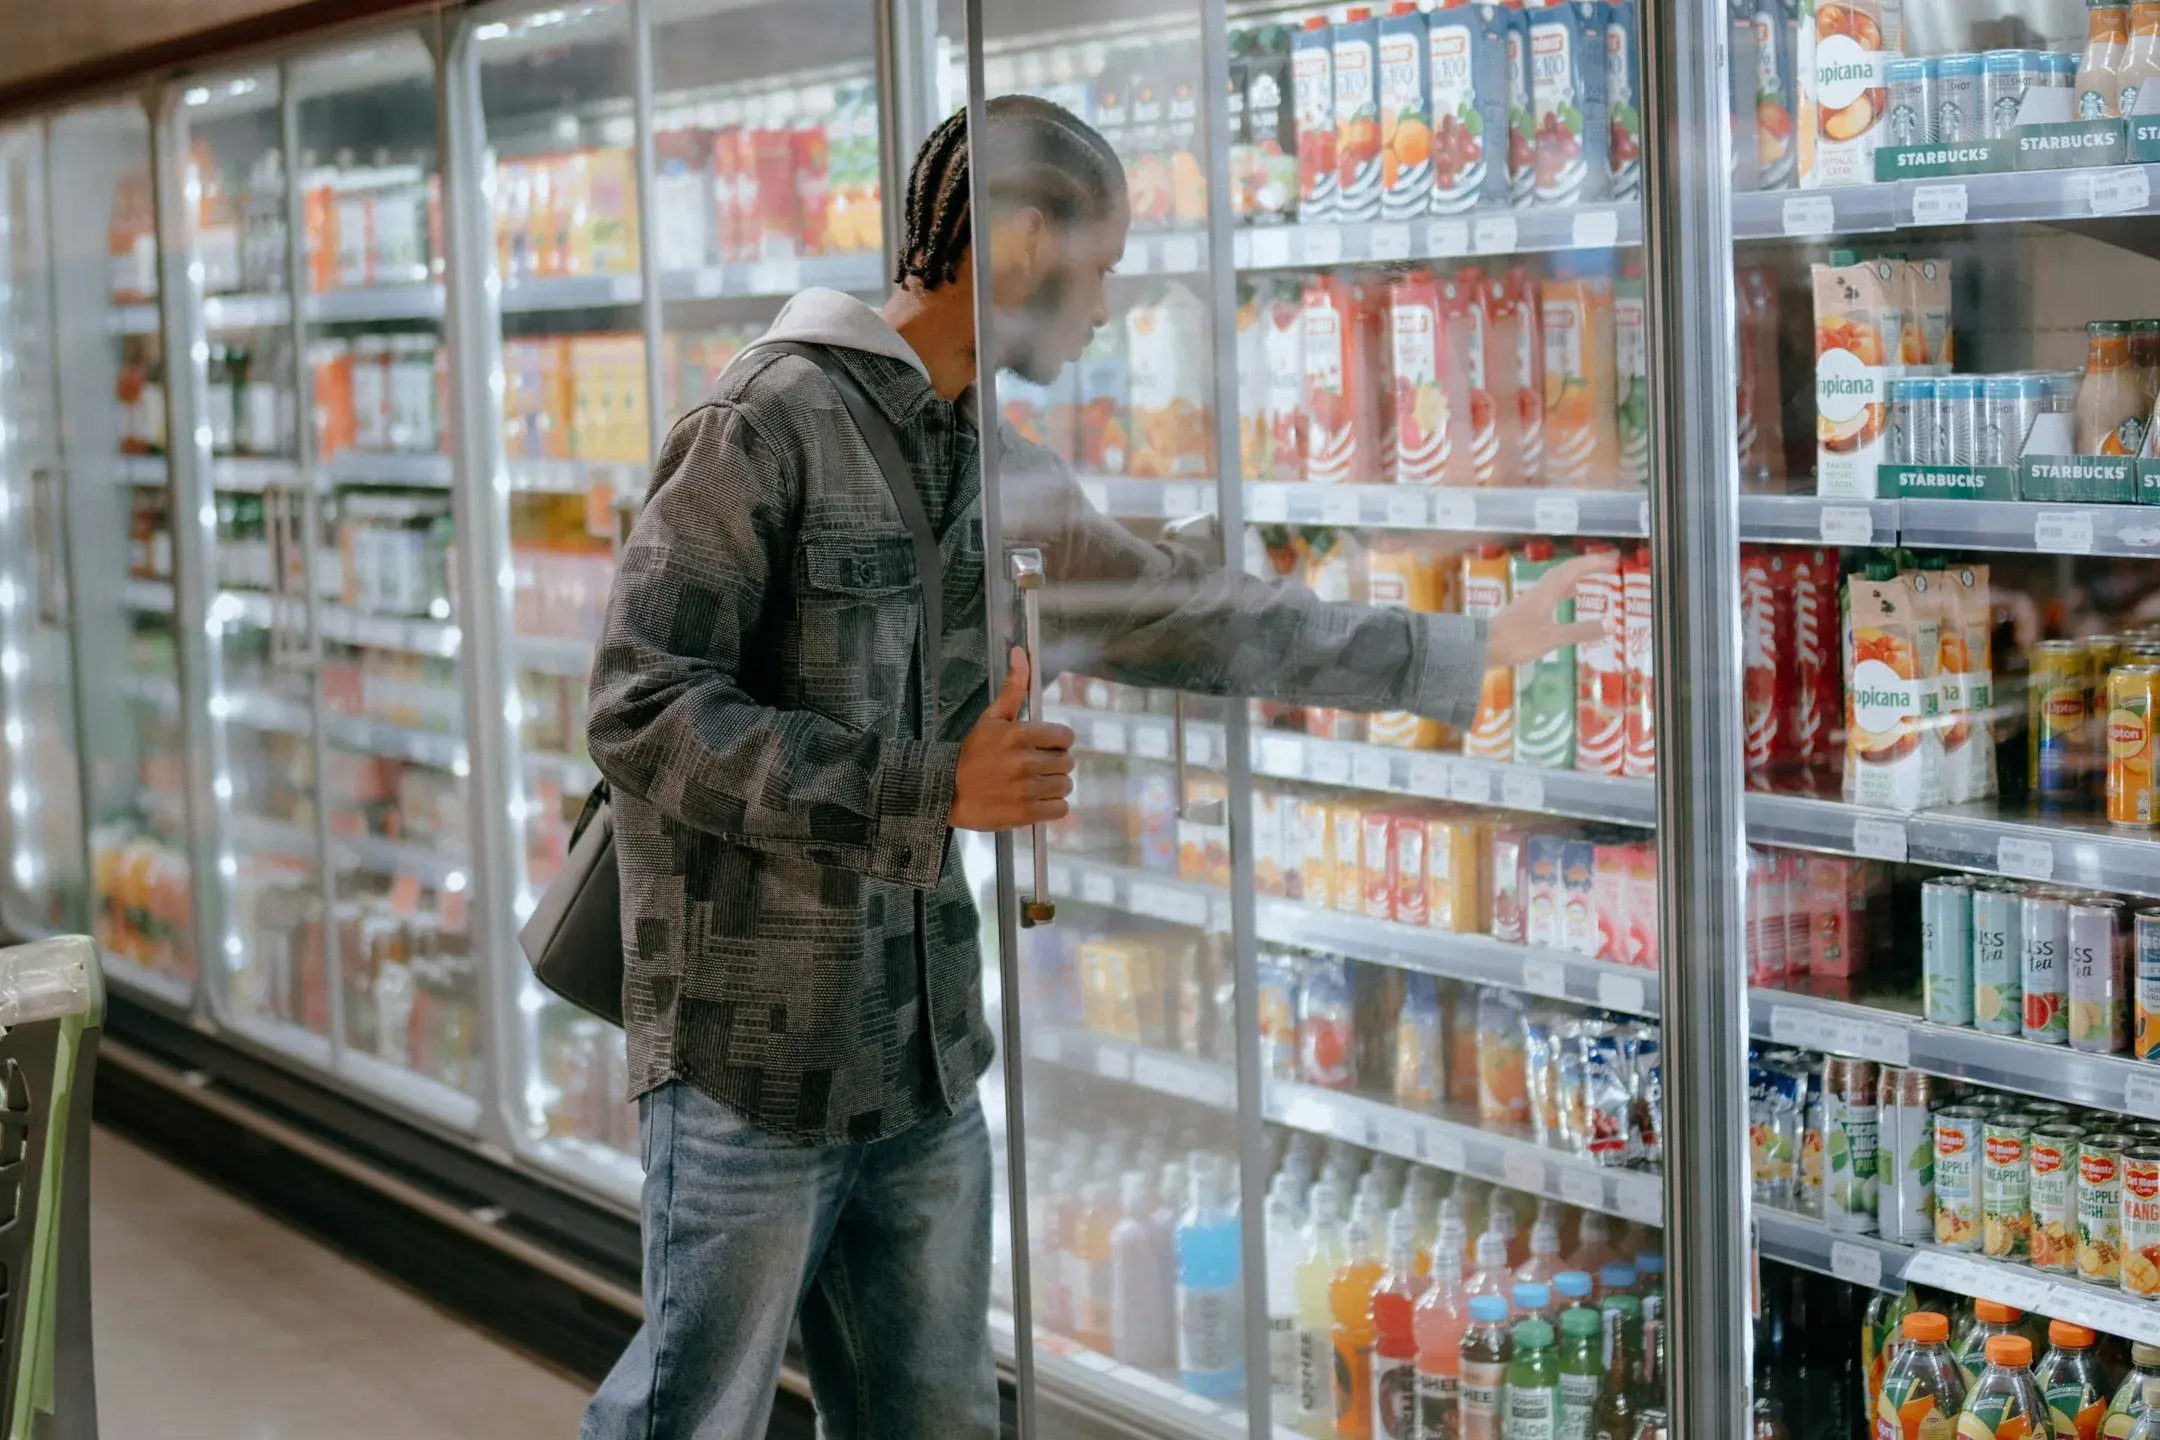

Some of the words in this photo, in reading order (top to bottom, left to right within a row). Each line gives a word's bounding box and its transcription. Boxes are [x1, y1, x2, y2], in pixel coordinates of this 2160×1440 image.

[1818, 61, 1874, 86] opicana
[2020, 131, 2116, 152] STARBUCKS
[1897, 147, 1988, 167] STARBUCKS
[1817, 374, 1874, 398] opicana
[1899, 472, 1985, 489] STARBUCKS
[2031, 464, 2126, 480] STARBUCKS
[1855, 685, 1911, 709] opicana
[2047, 701, 2082, 716] Lipton
[1980, 946, 2005, 963] tea
[2029, 956, 2053, 973] tea
[2072, 962, 2093, 979] tea
[1853, 1137, 1878, 1151] JUIC
[1996, 1145, 2020, 1155] Monte
[1940, 1160, 1970, 1175] APPLE
[2088, 1164, 2113, 1175] Monte
[2124, 1199, 2160, 1222] MANG
[1420, 1374, 1459, 1392] SHEE
[1463, 1388, 1494, 1404] HEE
[1512, 1420, 1549, 1438] Aloe
